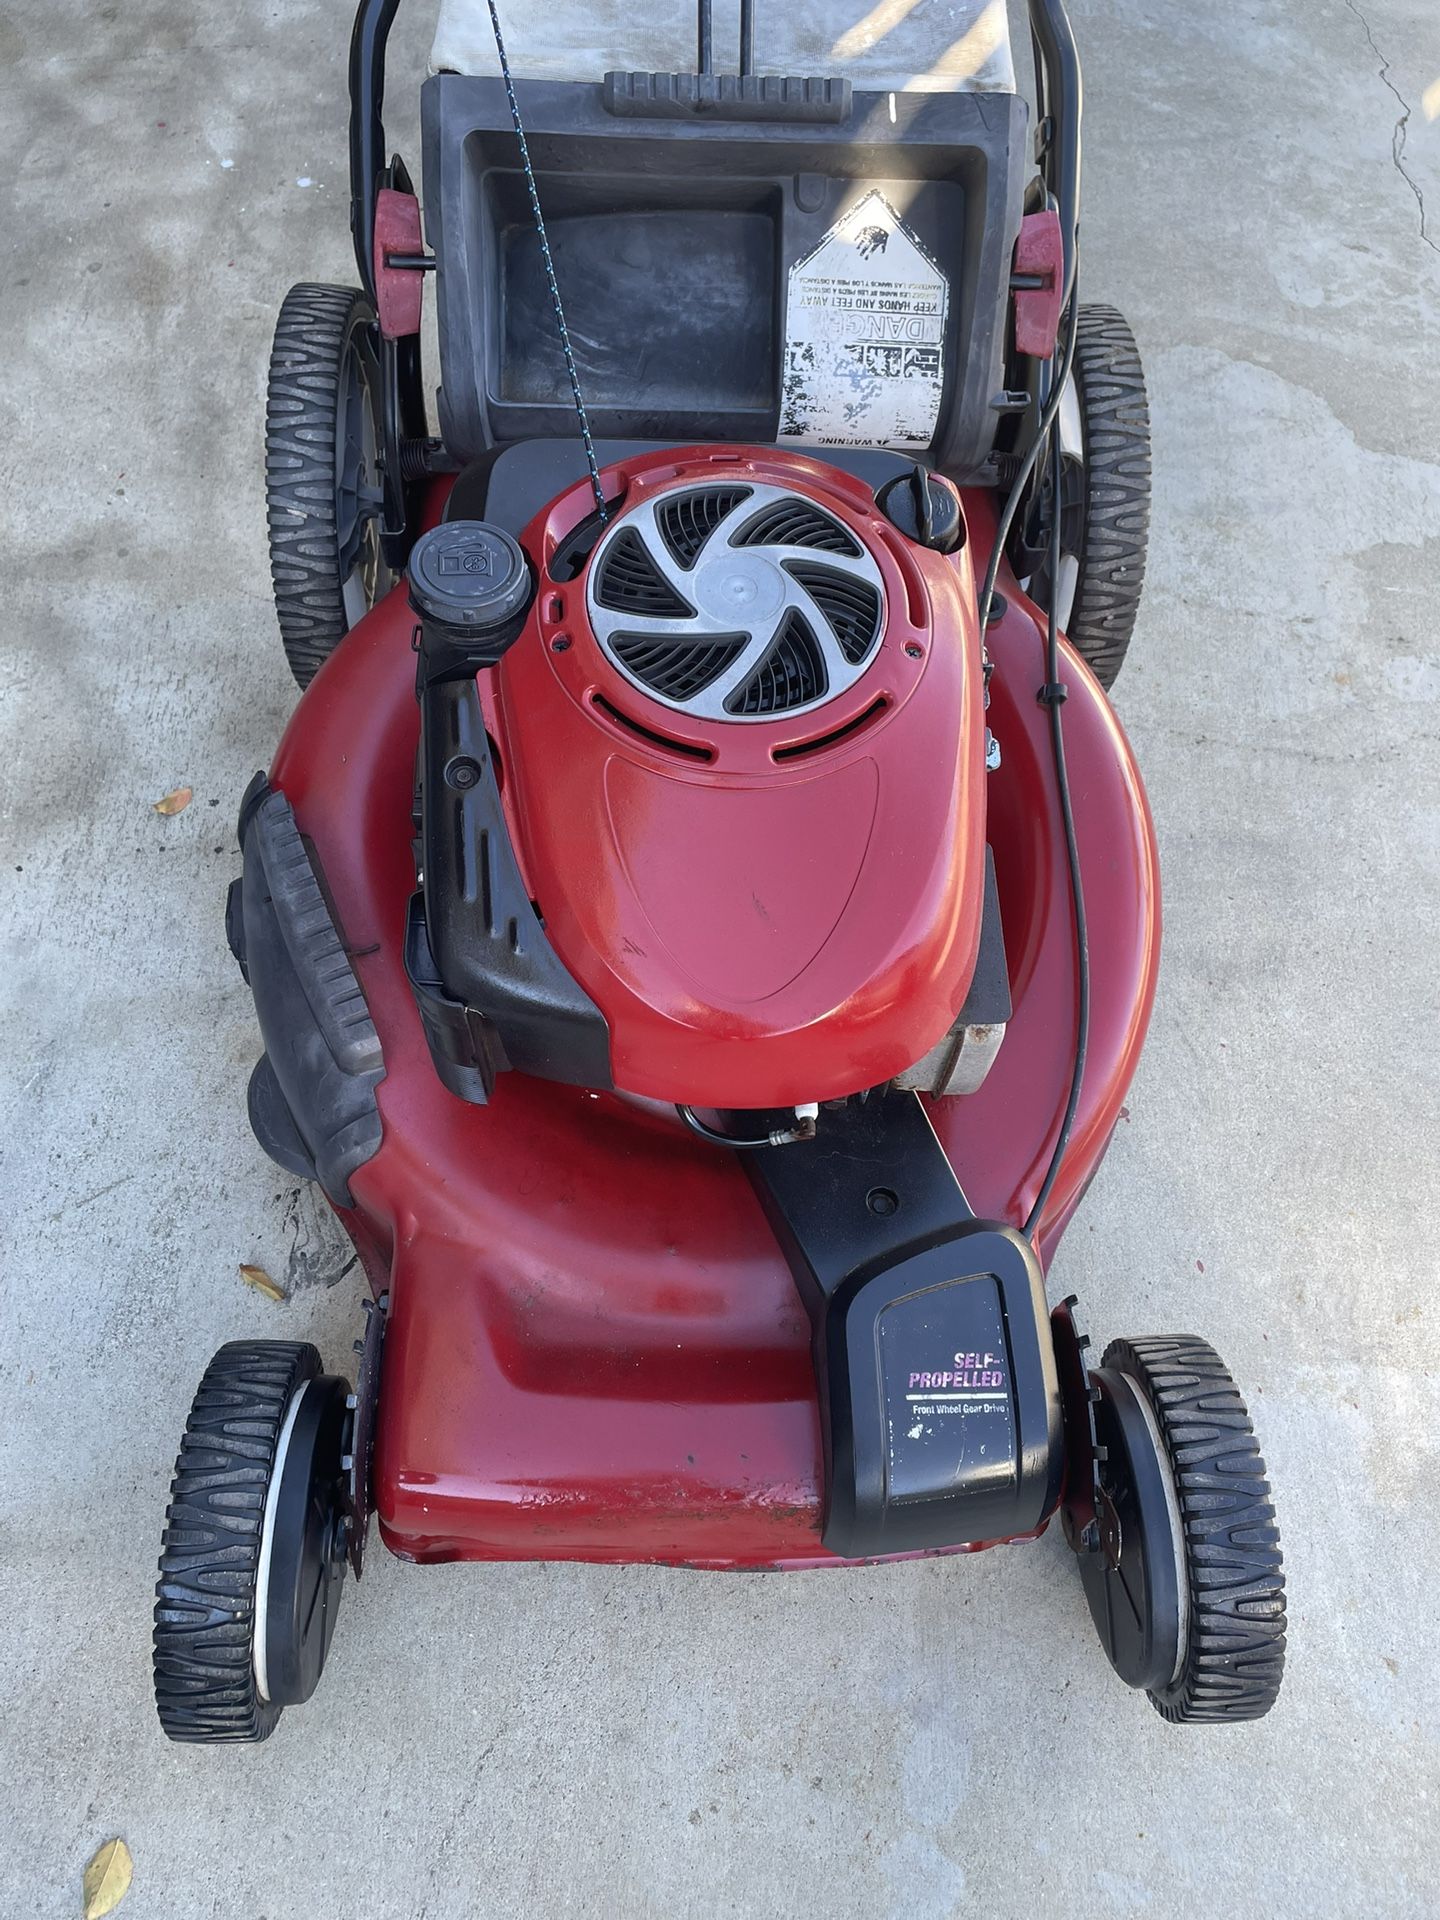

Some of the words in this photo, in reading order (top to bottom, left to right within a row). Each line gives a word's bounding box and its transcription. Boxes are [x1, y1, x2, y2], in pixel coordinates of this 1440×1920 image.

[799, 295, 829, 307] AWAY
[831, 297, 853, 309] FEET
[855, 298, 875, 310] AND
[878, 299, 911, 312] HANDS
[913, 301, 937, 313] KEEP
[953, 1352, 1001, 1370] SELF-
[908, 1370, 1004, 1389] PROPELLED
[912, 1404, 936, 1415] Front
[936, 1403, 962, 1415] Wheel
[962, 1403, 983, 1415] Gear
[983, 1402, 1006, 1414] Drive
